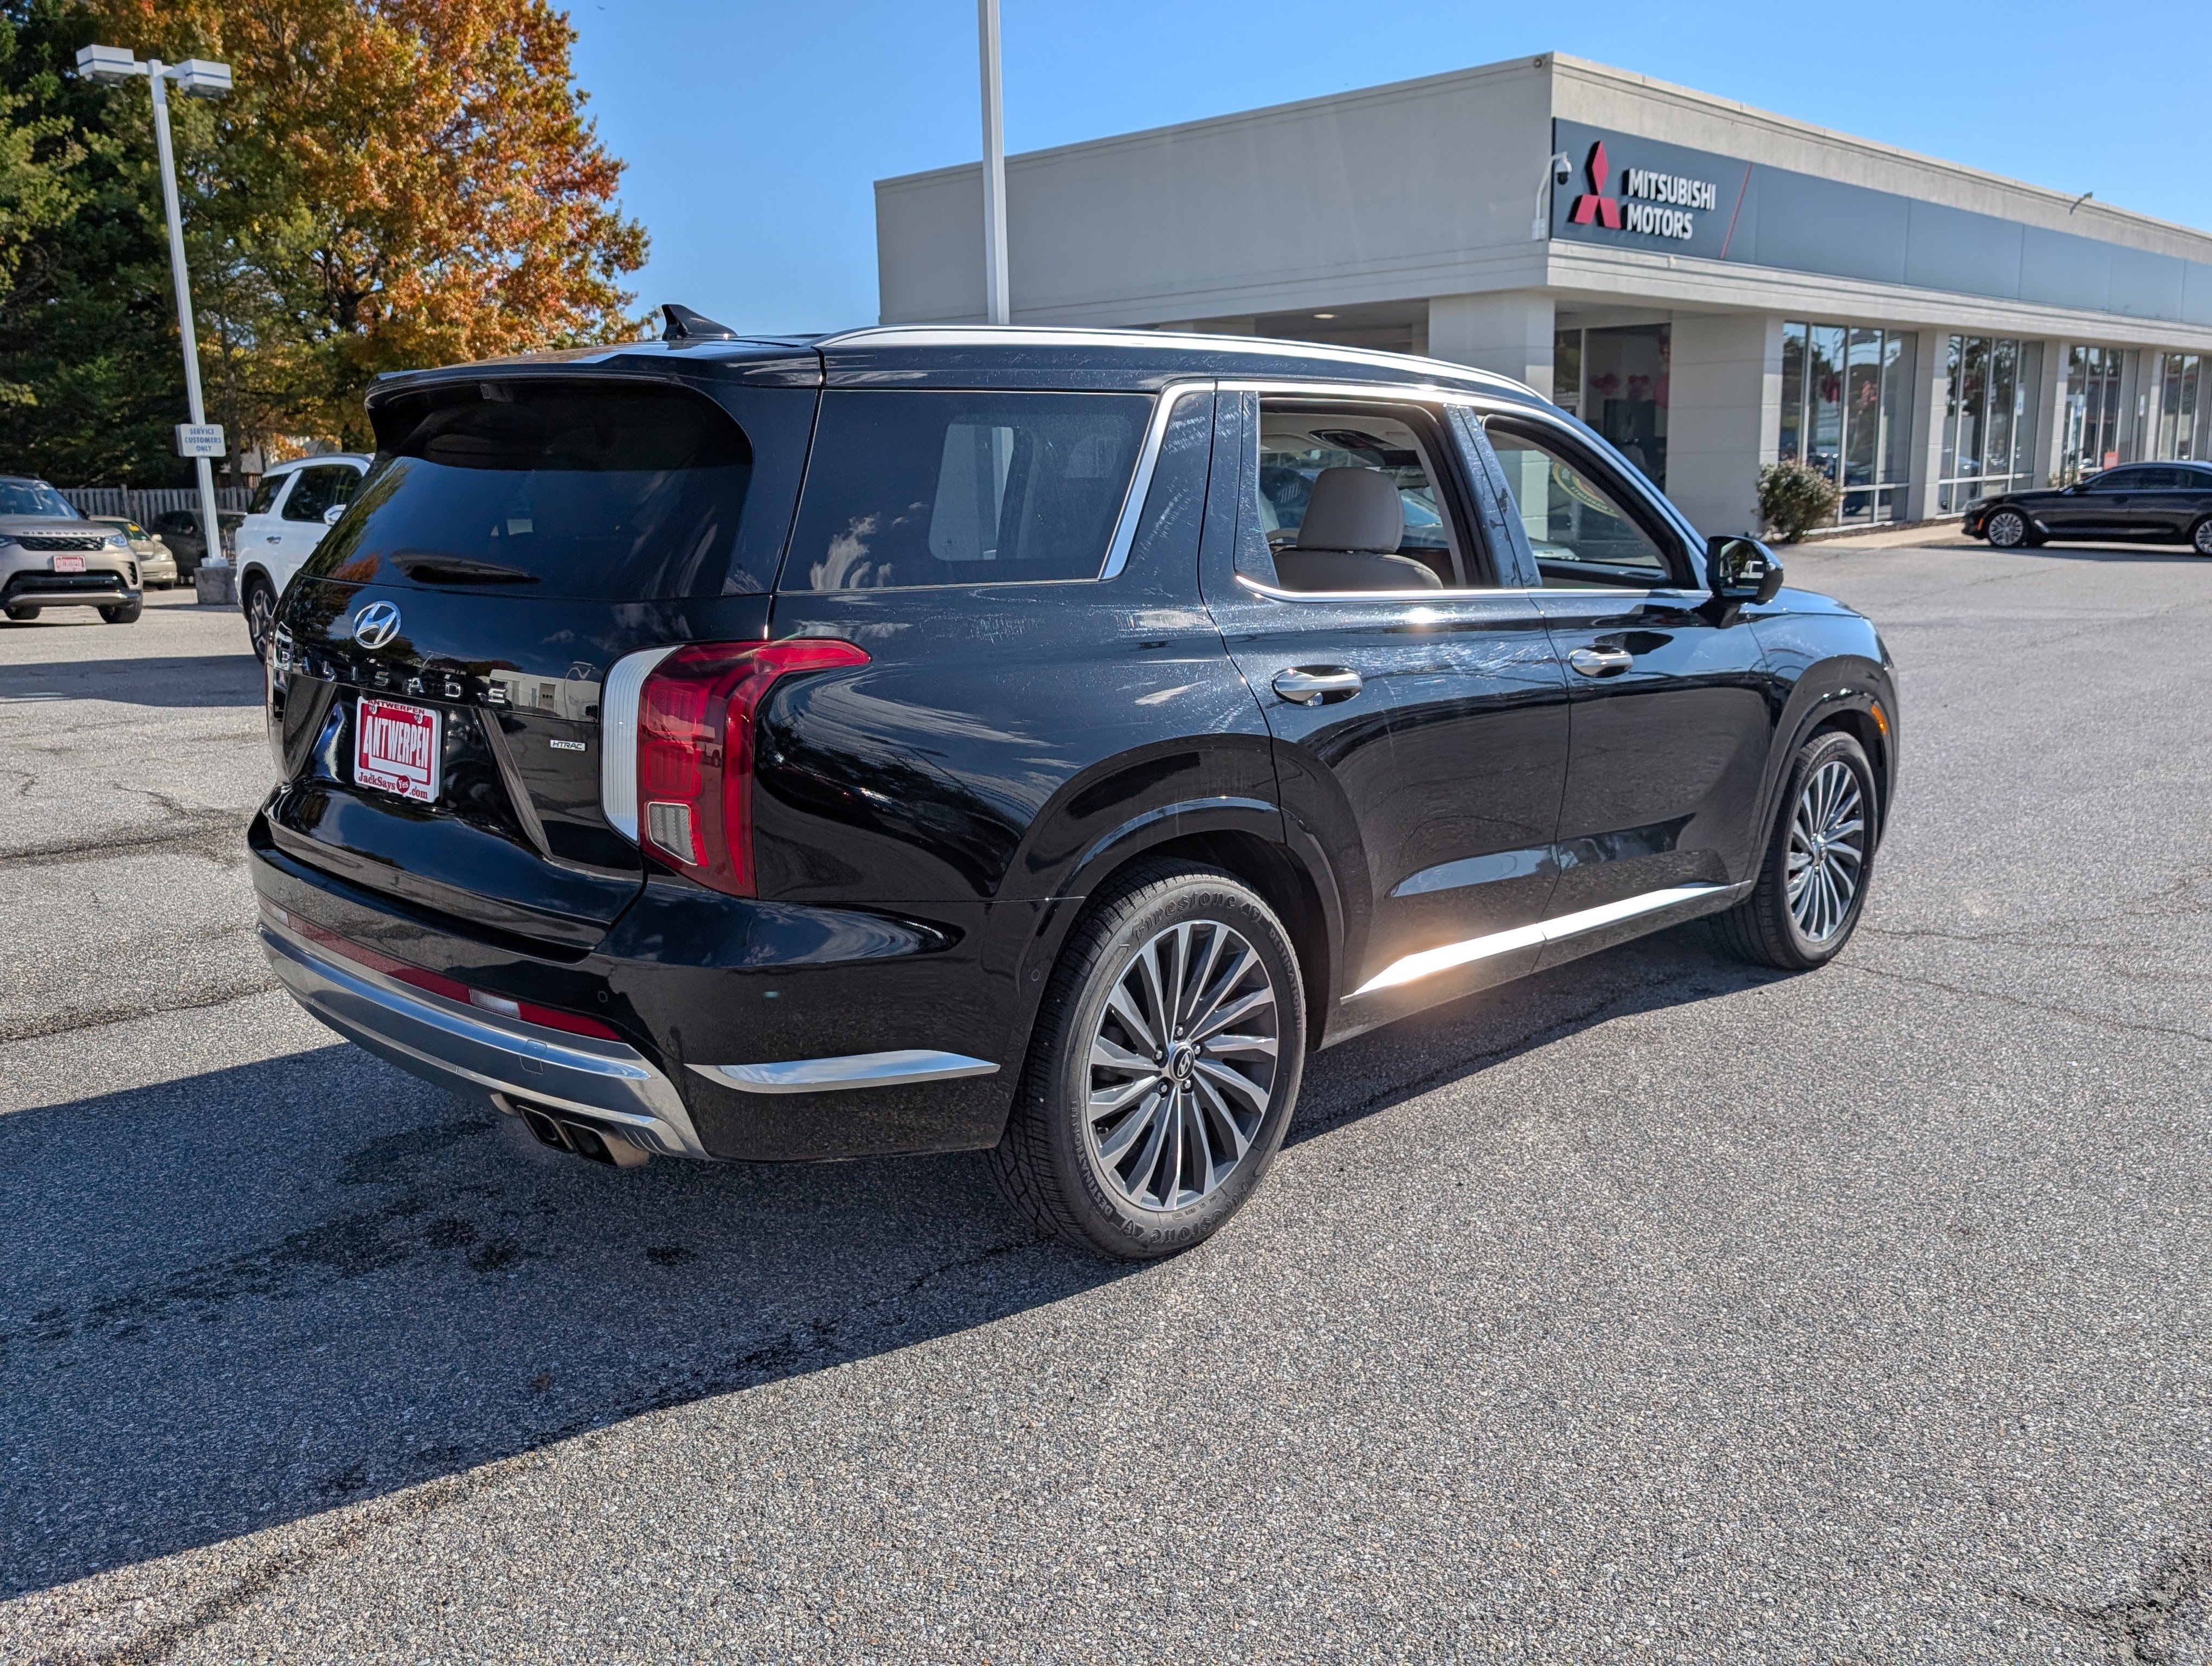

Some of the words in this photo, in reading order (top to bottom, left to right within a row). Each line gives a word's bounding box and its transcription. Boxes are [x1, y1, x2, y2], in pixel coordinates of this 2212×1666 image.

[1628, 168, 1716, 211] MITSUBISHI
[1627, 203, 1694, 240] MOTORS
[368, 699, 425, 715] ANTWERPEN
[363, 715, 429, 769] ANTWERPEN
[553, 741, 583, 749] HTRAC
[1131, 890, 1236, 941] Firestone
[1072, 1122, 1113, 1218] DESTINATION
